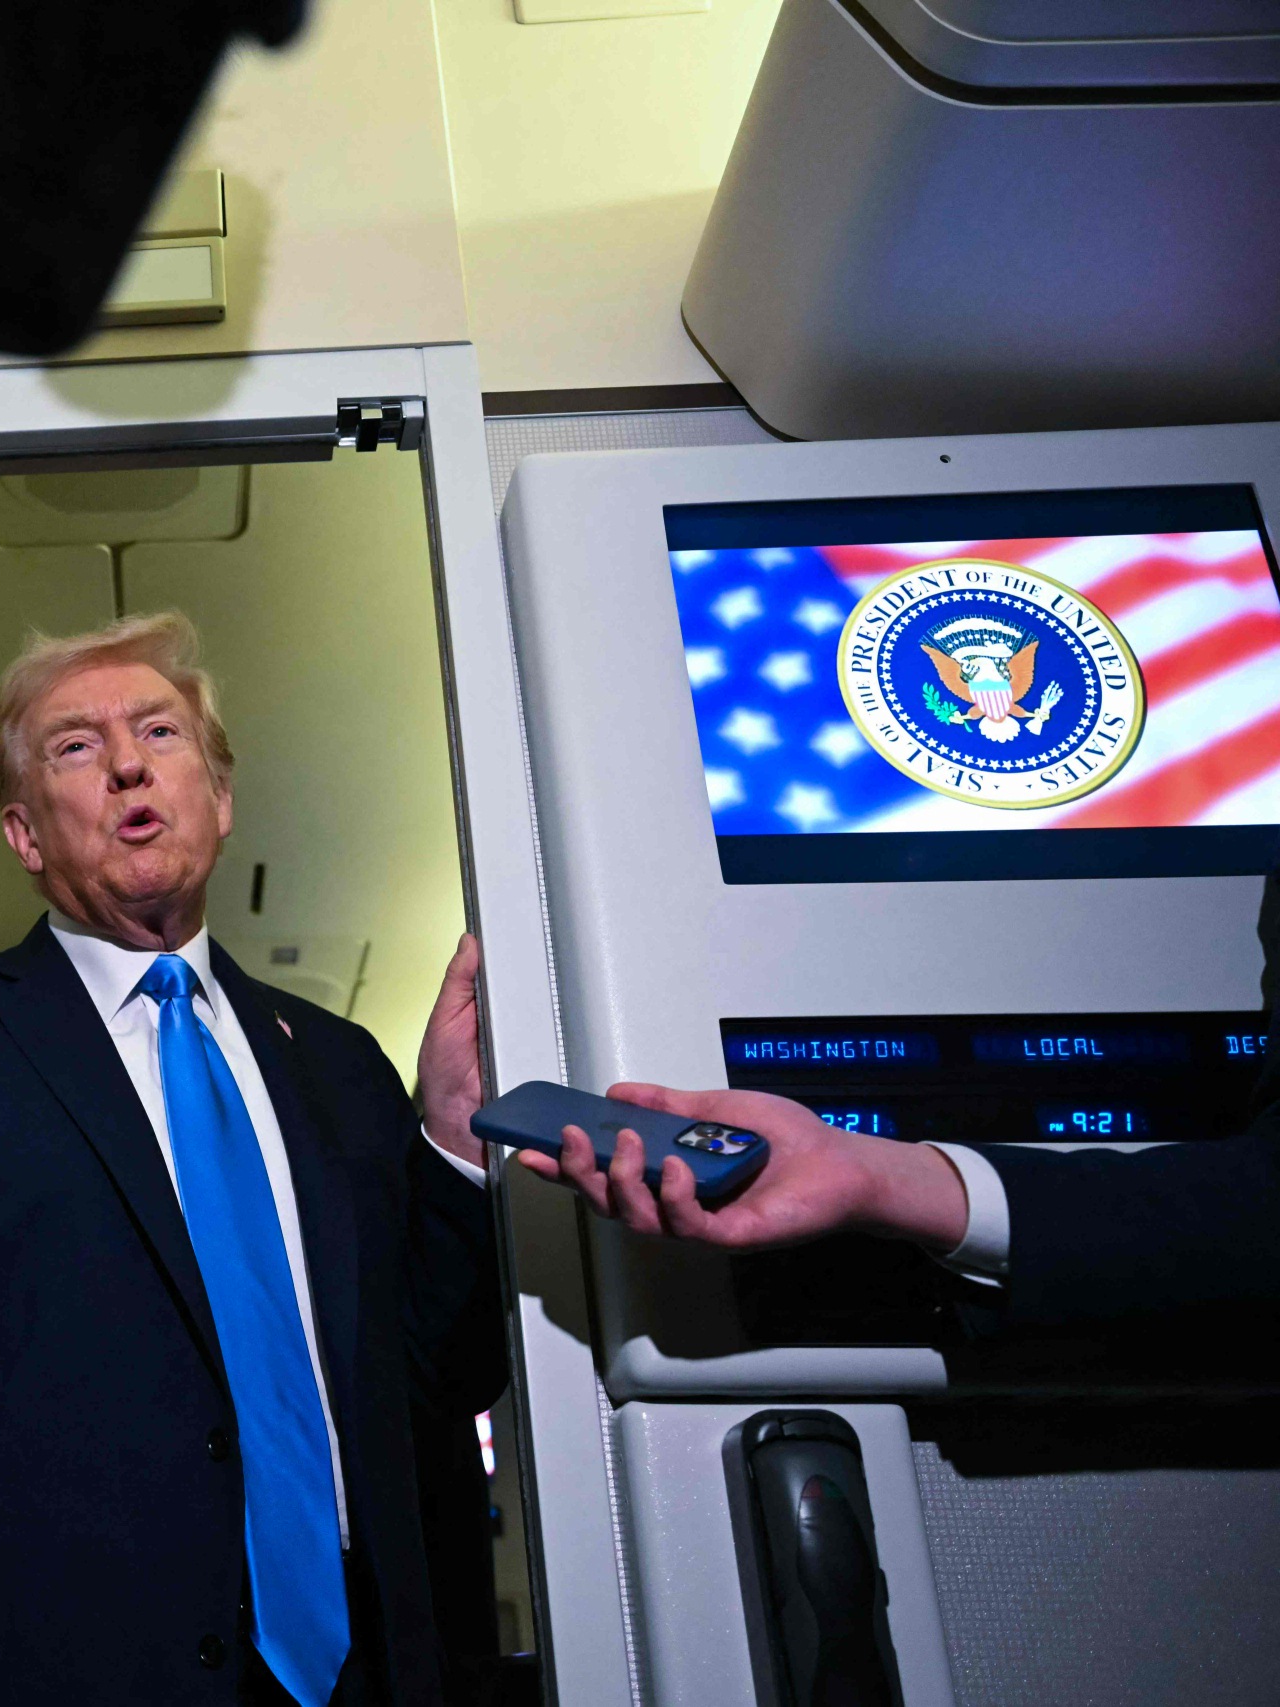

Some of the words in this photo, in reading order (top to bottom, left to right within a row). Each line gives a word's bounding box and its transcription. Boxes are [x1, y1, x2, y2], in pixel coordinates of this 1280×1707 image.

[966, 571, 993, 583] OF
[1001, 573, 1042, 598] THE
[851, 569, 957, 673] PRESIDENT
[1050, 594, 1127, 690] UNITED
[856, 681, 879, 715] THE
[876, 723, 899, 742] OF
[1040, 713, 1126, 790] STATES
[907, 742, 984, 792] SEAL
[744, 1040, 905, 1059] WASHINGTON
[1023, 1038, 1104, 1056] LOCAL
[1049, 1123, 1064, 1131] PM
[1072, 1112, 1132, 1133] 9:21
